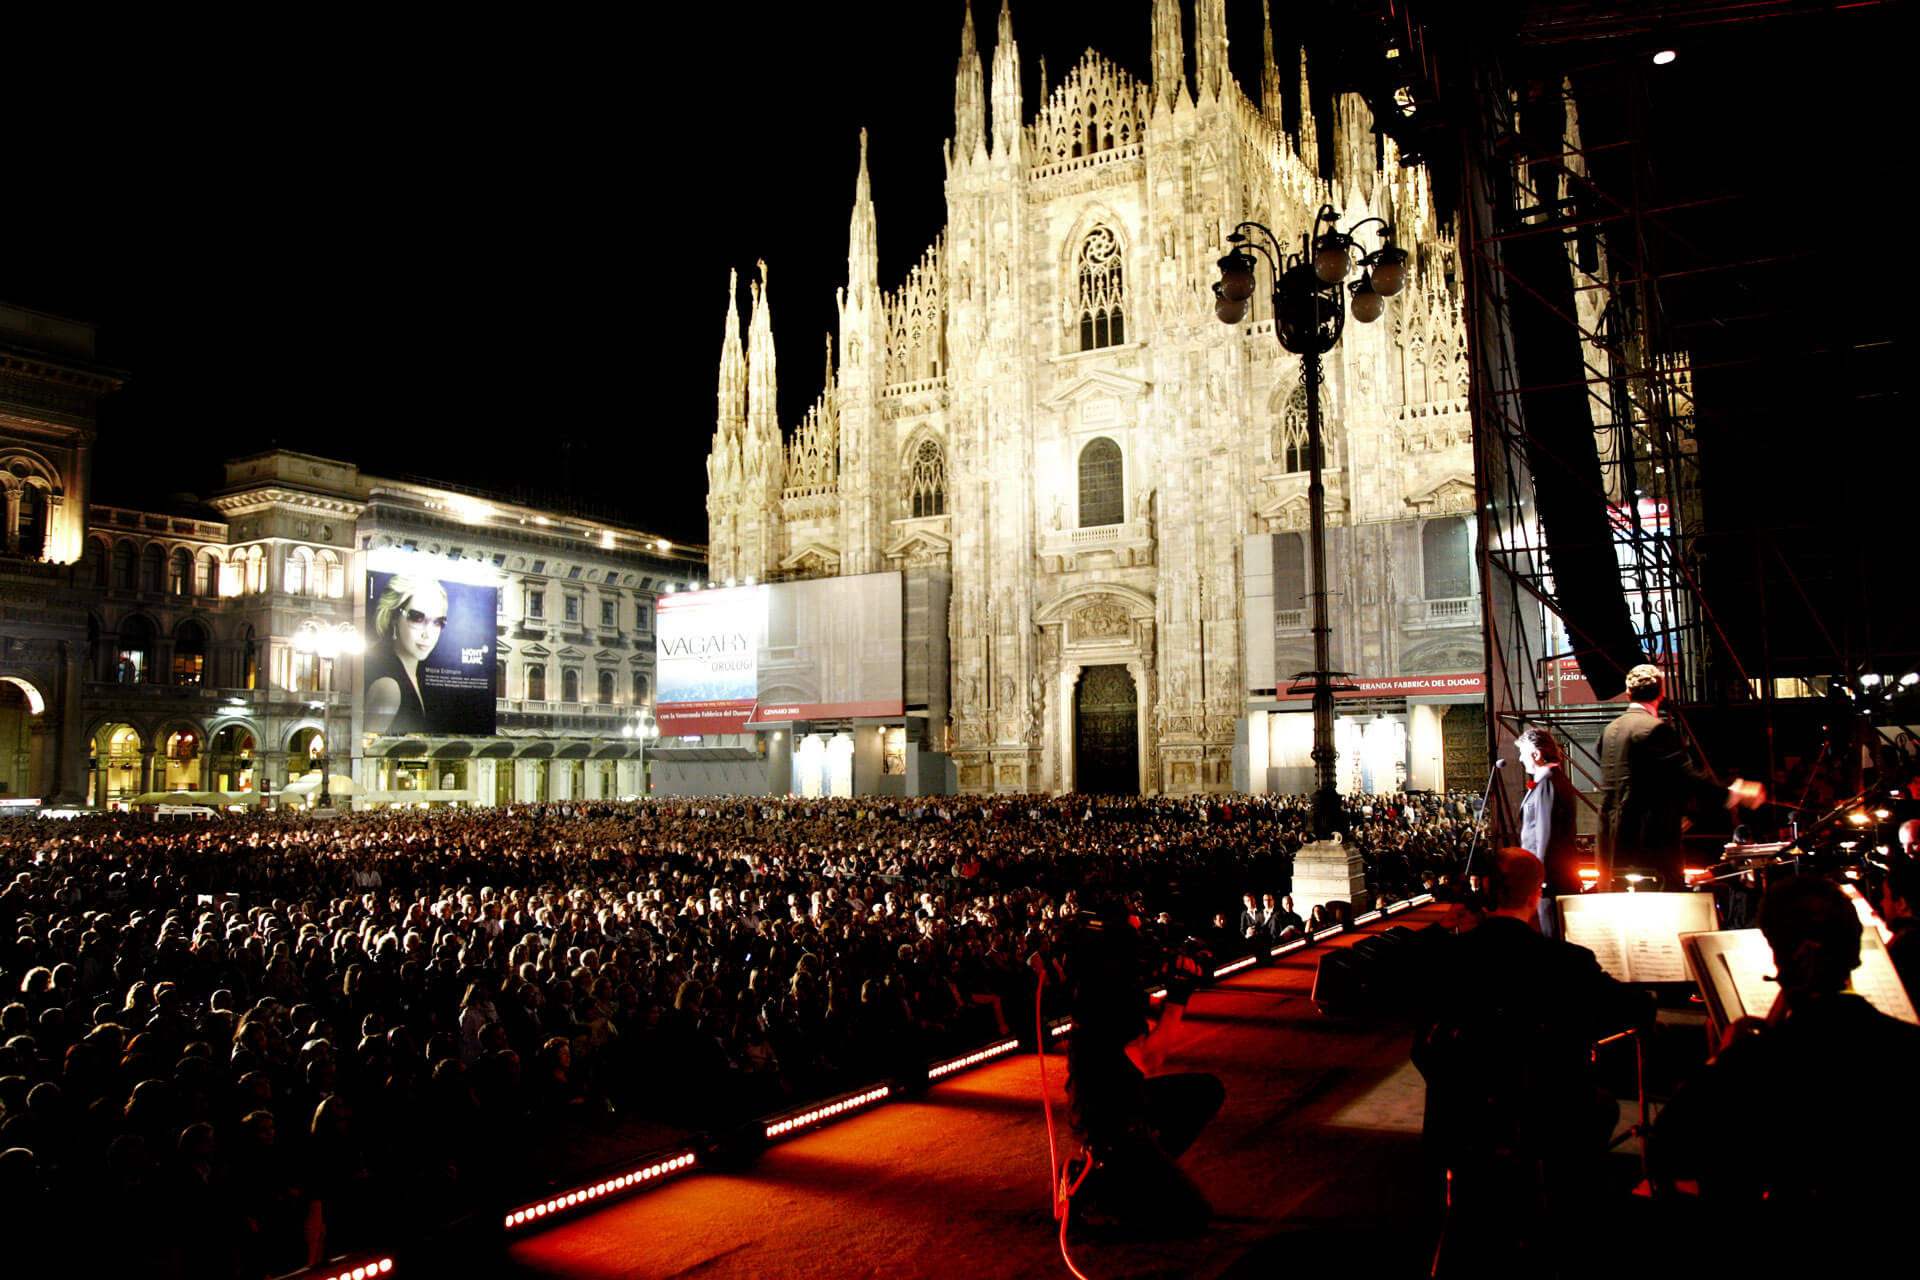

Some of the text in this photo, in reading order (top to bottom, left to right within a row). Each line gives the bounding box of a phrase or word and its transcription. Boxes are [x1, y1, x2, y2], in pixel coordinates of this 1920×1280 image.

[660, 631, 749, 656] VAGARY
[461, 647, 483, 657] MONT
[461, 655, 483, 665] BLANC
[711, 659, 753, 673] OROLOGI
[1394, 680, 1430, 689] FABBRICA
[1431, 679, 1446, 687] DEL
[1447, 678, 1481, 687] DUOMO
[701, 709, 723, 718] Fabbrica
[723, 708, 732, 717] del
